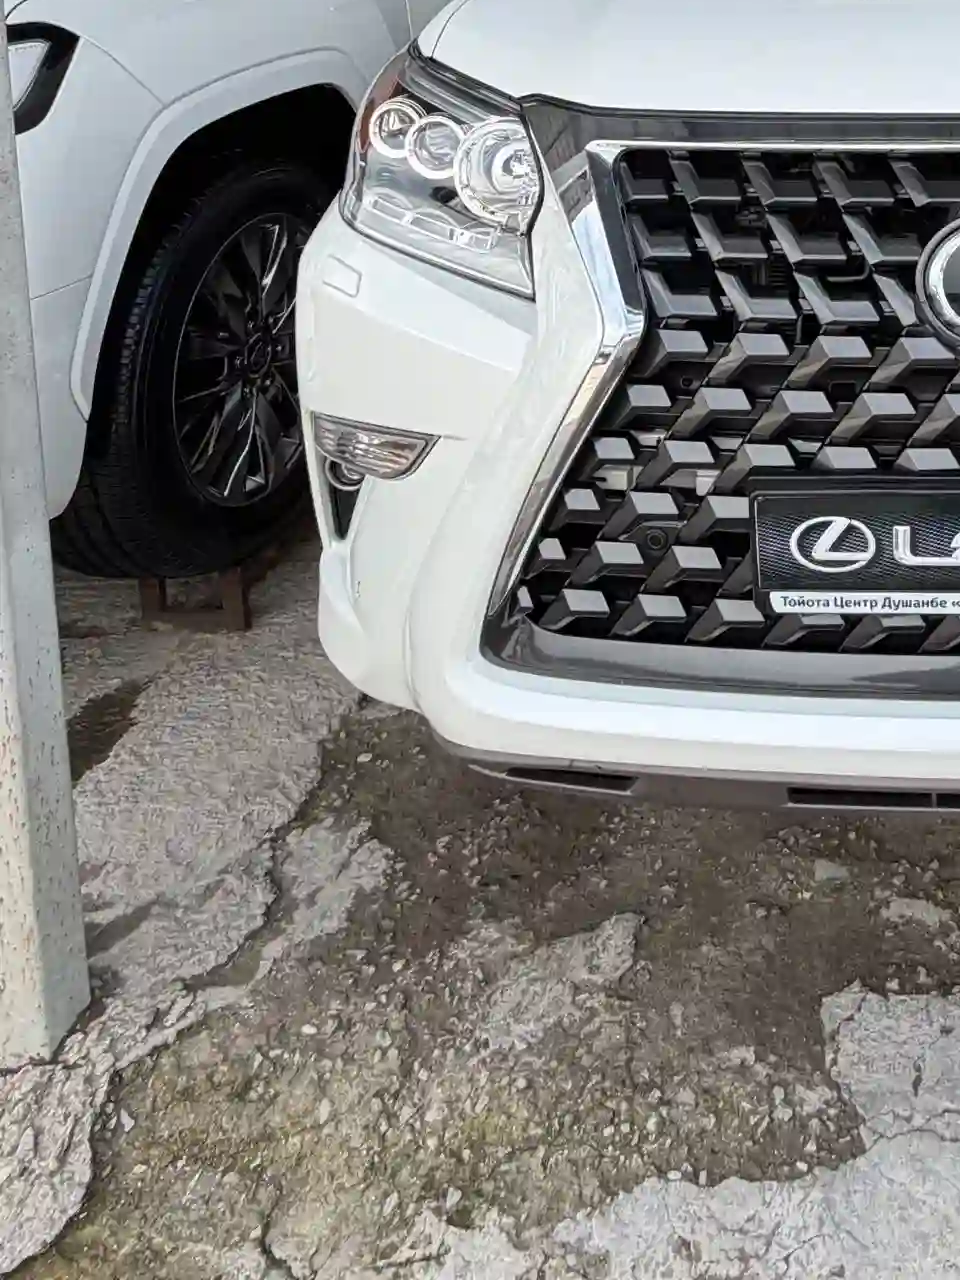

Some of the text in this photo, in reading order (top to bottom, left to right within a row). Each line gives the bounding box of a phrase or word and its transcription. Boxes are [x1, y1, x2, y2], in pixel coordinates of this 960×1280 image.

[780, 595, 831, 609] Тойота
[834, 596, 878, 612] Центр
[881, 596, 947, 612] Душанбе
